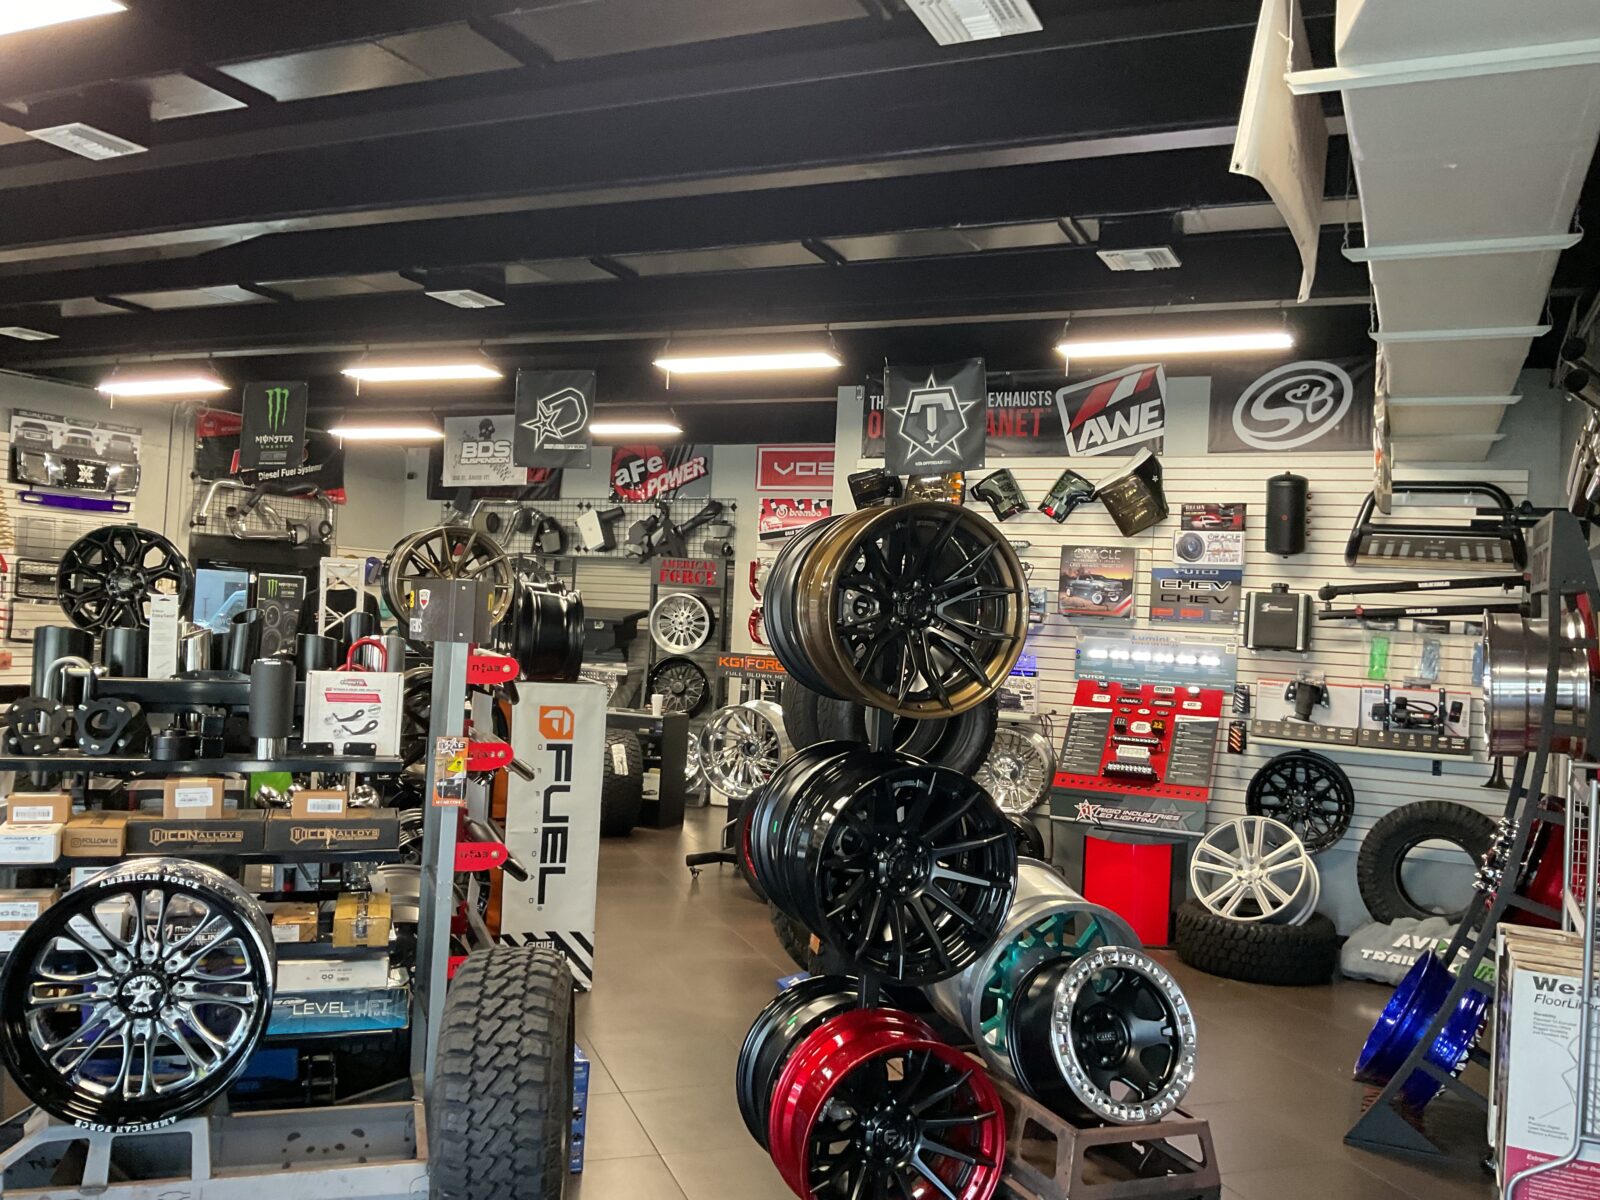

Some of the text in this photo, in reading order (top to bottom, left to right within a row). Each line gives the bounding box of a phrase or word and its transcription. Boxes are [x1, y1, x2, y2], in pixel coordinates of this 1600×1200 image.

[987, 391, 1052, 407] EXHAUSTS
[1250, 374, 1334, 438] S&B
[868, 411, 885, 439] O
[1078, 398, 1163, 450] AWE
[461, 440, 511, 458] BDS
[460, 456, 510, 465] SUSPENSION
[258, 464, 324, 481] Diesel Fuel Systems
[614, 455, 663, 487] aFe
[647, 456, 708, 497] POWER
[789, 508, 822, 517] brembo
[1073, 547, 1122, 560] ORACLE
[661, 559, 716, 570] AMERICAN
[659, 570, 716, 586] FORCE
[1160, 578, 1231, 591] CHEV
[1160, 594, 1230, 604] CHEV
[719, 656, 744, 668] KG1
[1097, 806, 1180, 821] RIGID INDUSTRIES
[1113, 813, 1158, 824] LIGHTING
[537, 743, 574, 905] FUEL
[164, 830, 243, 841] ICON ALLOYS
[305, 828, 380, 839] ICON ALLOYS
[99, 873, 200, 889] AMERICAN FORCE
[292, 1001, 350, 1016] LEVEL
[74, 1116, 177, 1133] AMERICAN FORCE
